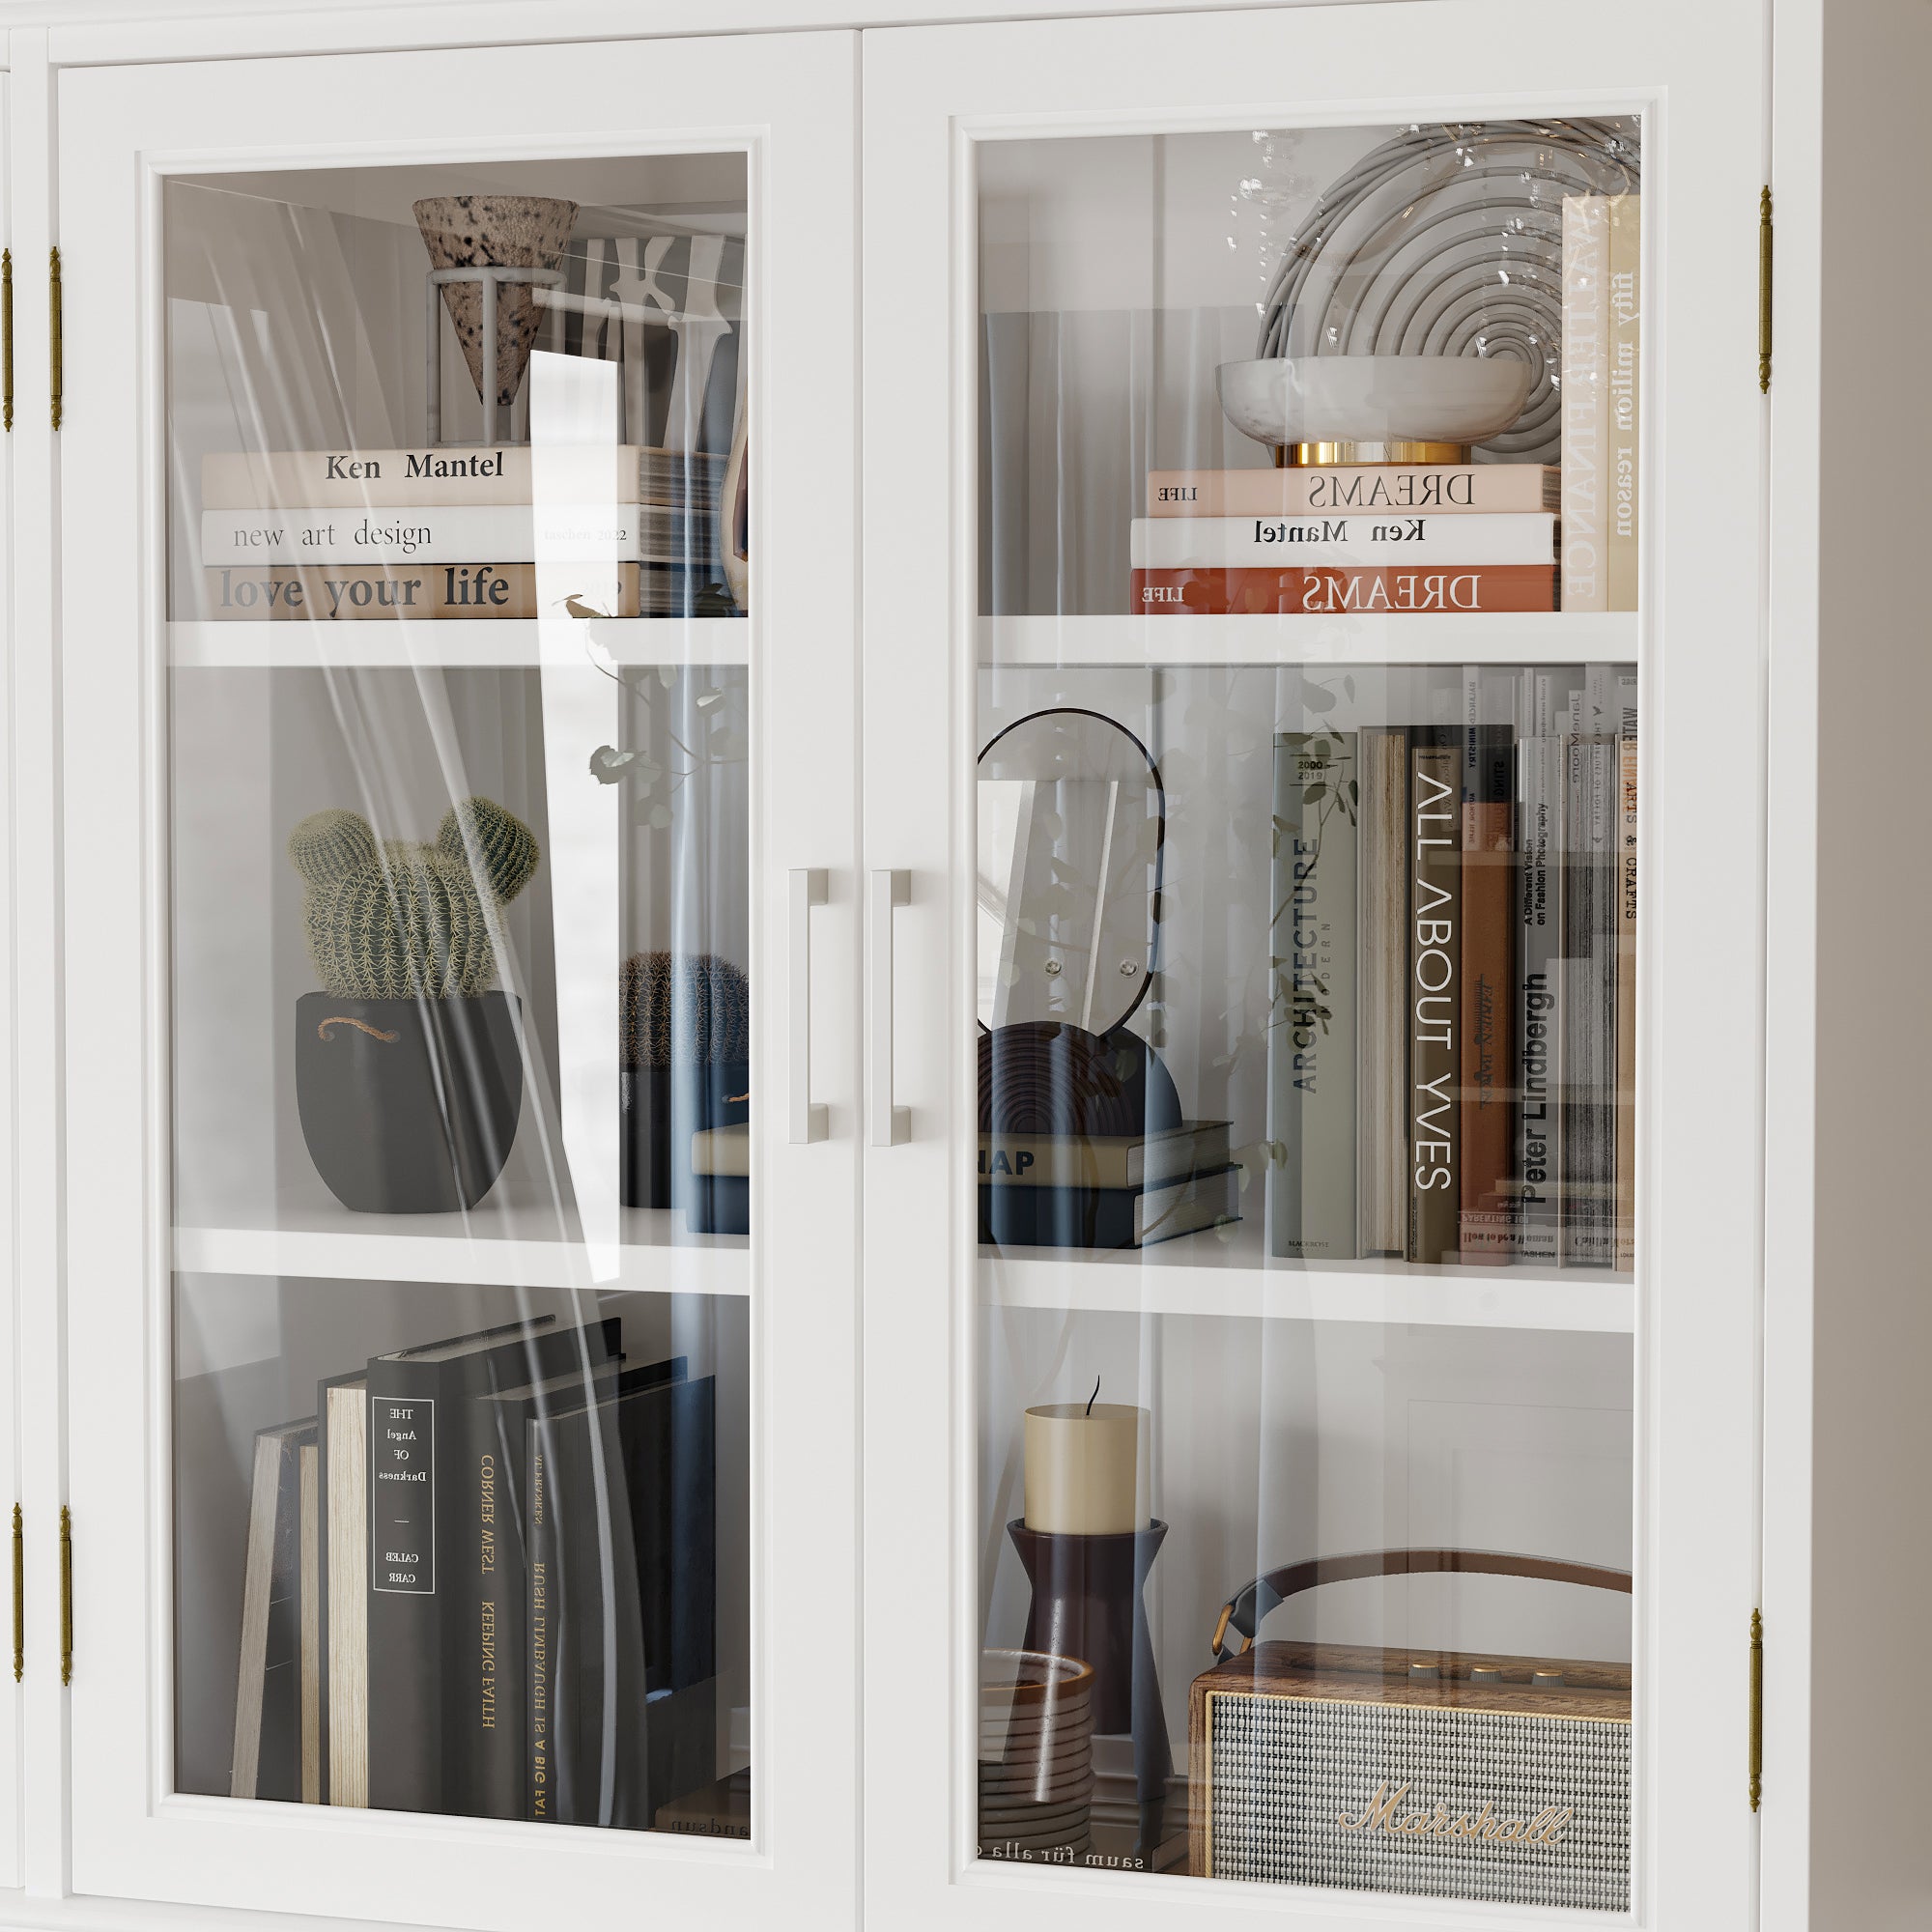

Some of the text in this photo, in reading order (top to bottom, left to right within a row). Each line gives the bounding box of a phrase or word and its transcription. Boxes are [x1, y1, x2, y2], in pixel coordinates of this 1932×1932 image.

[325, 451, 504, 480] Ken Mantel
[233, 519, 433, 553] new art design
[219, 565, 510, 617] love your life
[1297, 760, 1323, 770] 2000
[1297, 771, 1323, 781] 2019
[1416, 771, 1453, 861] ALL
[1536, 803, 1548, 867] Photography
[1523, 838, 1533, 926] A Different Vision
[1536, 869, 1546, 910] Fashion
[1626, 857, 1637, 920] CRAFTS
[1537, 913, 1546, 925] on
[1293, 838, 1319, 1094] ARCHITECTURE
[1415, 877, 1453, 1050] ABOUT
[1521, 972, 1555, 1204] Peter Lindbergh
[1415, 1072, 1452, 1190] YVES
[1338, 1779, 1576, 1848] Marshall
